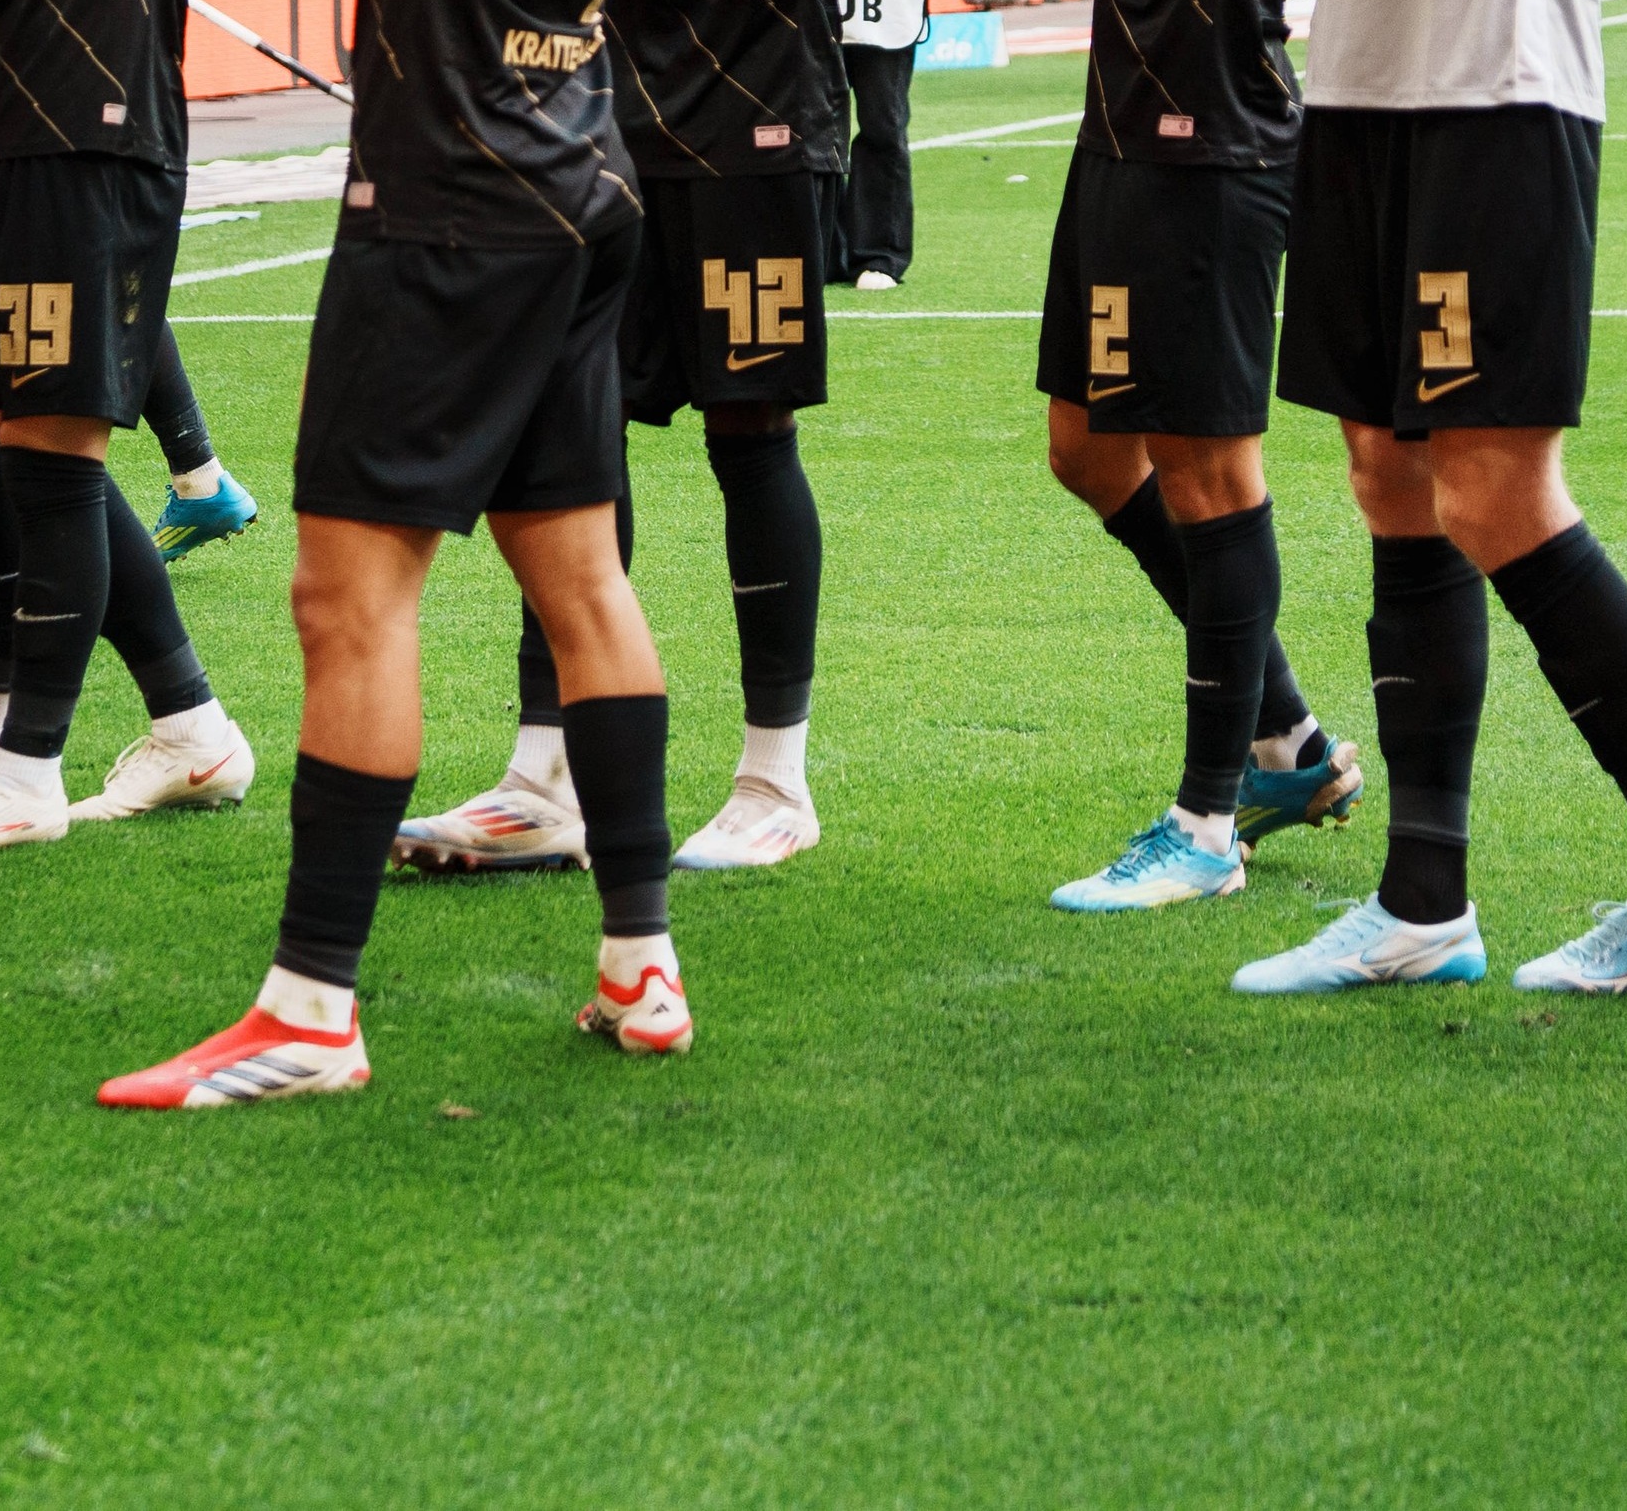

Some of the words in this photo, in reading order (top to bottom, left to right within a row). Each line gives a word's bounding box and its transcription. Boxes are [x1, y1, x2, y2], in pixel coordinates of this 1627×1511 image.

[703, 257, 805, 346] 42
[1090, 285, 1130, 376] 2
[1418, 271, 1475, 371] 3
